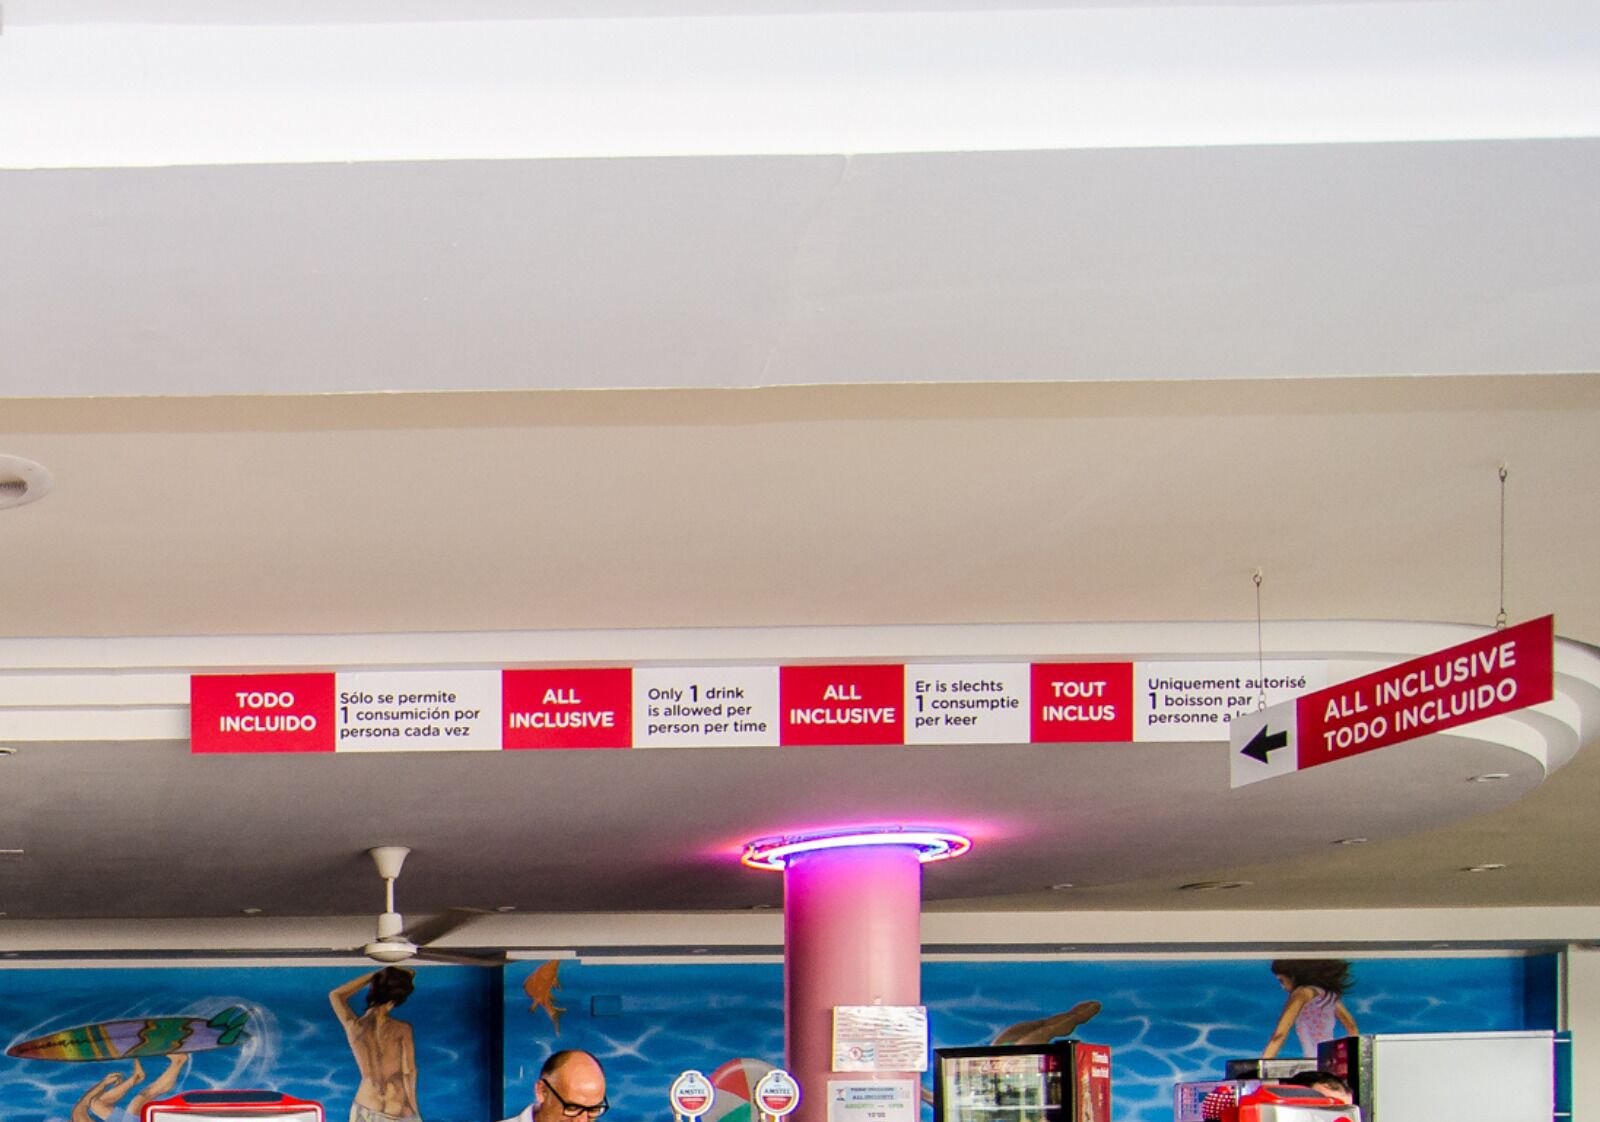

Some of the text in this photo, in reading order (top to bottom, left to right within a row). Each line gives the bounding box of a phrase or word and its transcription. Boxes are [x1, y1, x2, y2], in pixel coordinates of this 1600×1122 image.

[915, 679, 1004, 693] Er is slechts
[1051, 681, 1107, 698] TOUT
[1148, 675, 1306, 692] Uniquement autorisé
[1324, 640, 1517, 722] ALL INCLUSIVE
[236, 692, 294, 708] TODO
[340, 690, 456, 706] Sólo se permite
[542, 688, 581, 704] ALL
[648, 685, 744, 704] Only 1 drink
[823, 684, 862, 701] ALL
[1149, 692, 1252, 709] 1 boisson par
[648, 703, 752, 719] is allowed per
[915, 695, 1019, 712] 1 consumptie
[340, 706, 480, 724] 1 consumición por
[509, 711, 615, 729] INCLUSIVE
[790, 707, 896, 726] INCLUSIVE
[915, 712, 977, 728] per keer
[1042, 704, 1115, 723] INCLUS
[1148, 710, 1218, 726] personne
[1324, 678, 1518, 752] TODO INCLUIDO
[220, 714, 316, 732] INCLUIDO
[647, 719, 767, 737] person per time
[340, 724, 470, 740] persona cada vez
